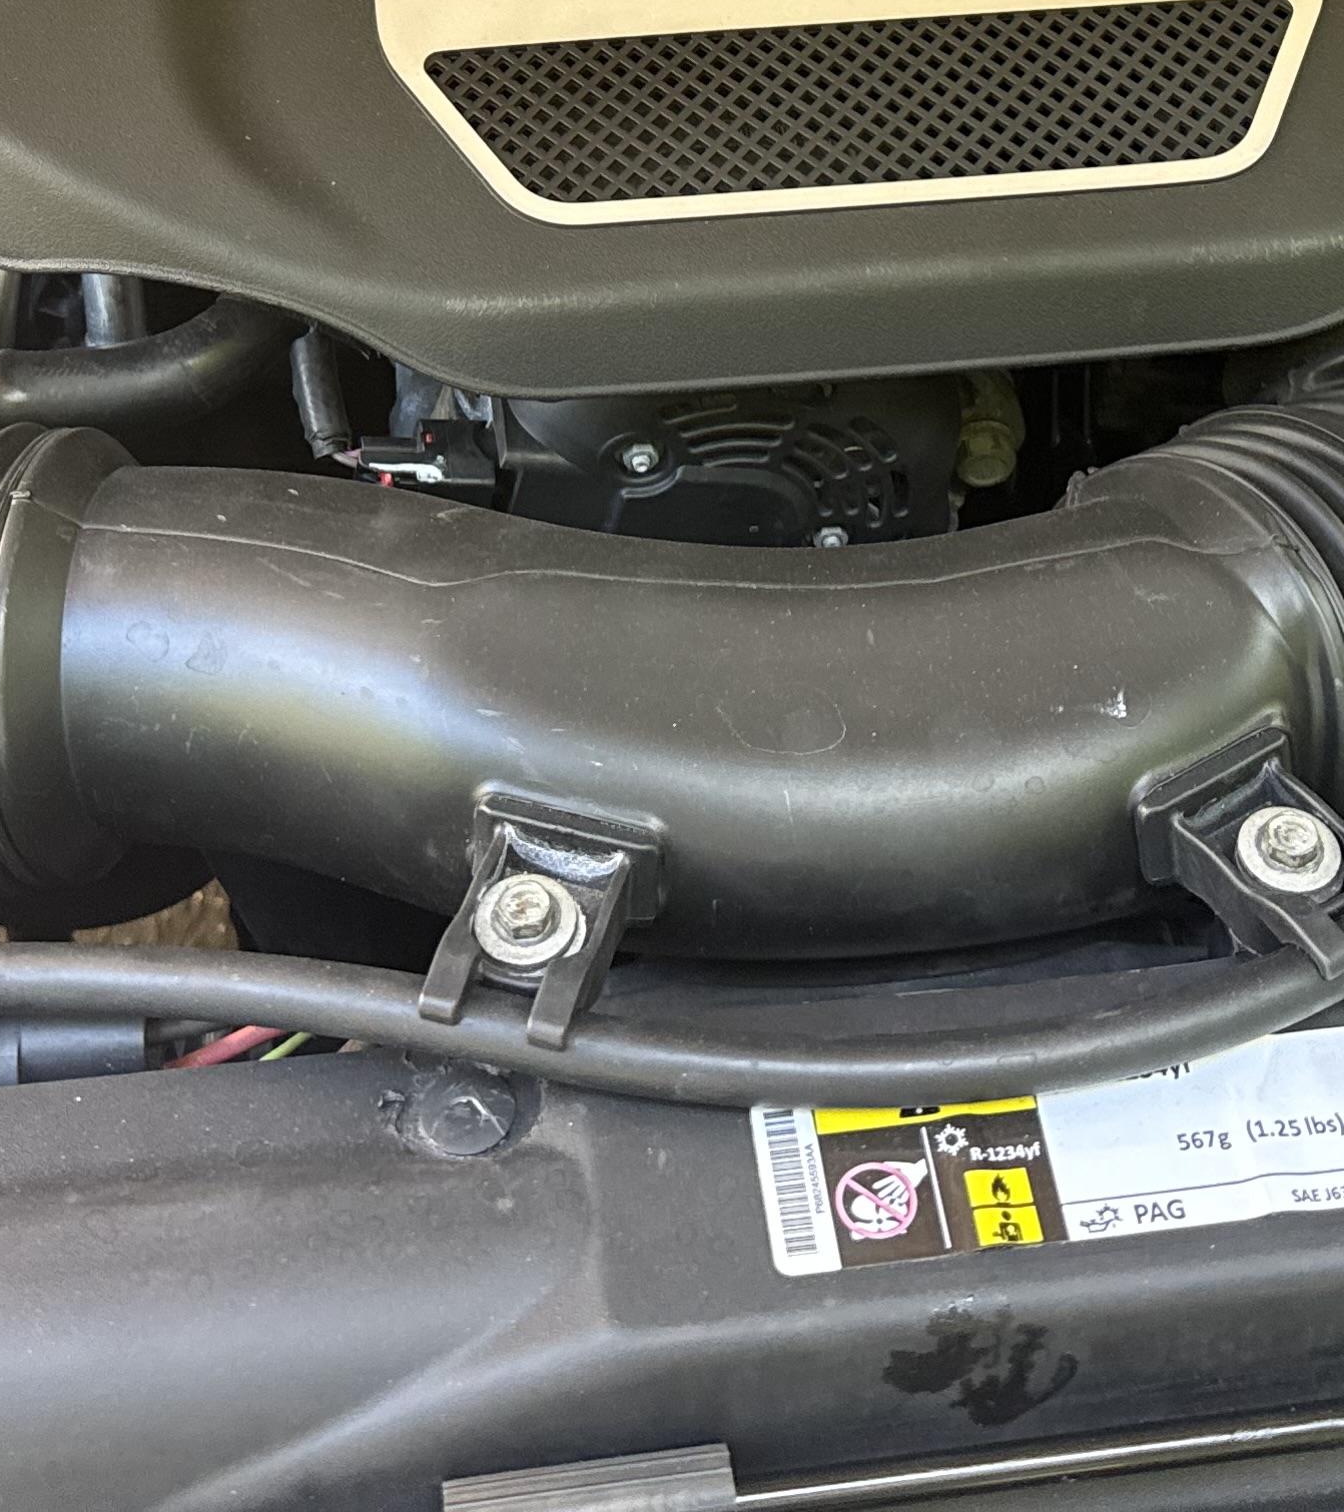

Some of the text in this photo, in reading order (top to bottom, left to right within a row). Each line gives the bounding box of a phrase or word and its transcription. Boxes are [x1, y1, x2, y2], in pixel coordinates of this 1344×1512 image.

[1176, 1128, 1233, 1154] 567g
[1244, 1116, 1301, 1142] (1.25
[968, 1141, 1043, 1166] R-1234yf
[1291, 1188, 1321, 1203] SAE
[1132, 1199, 1186, 1225] PAG
